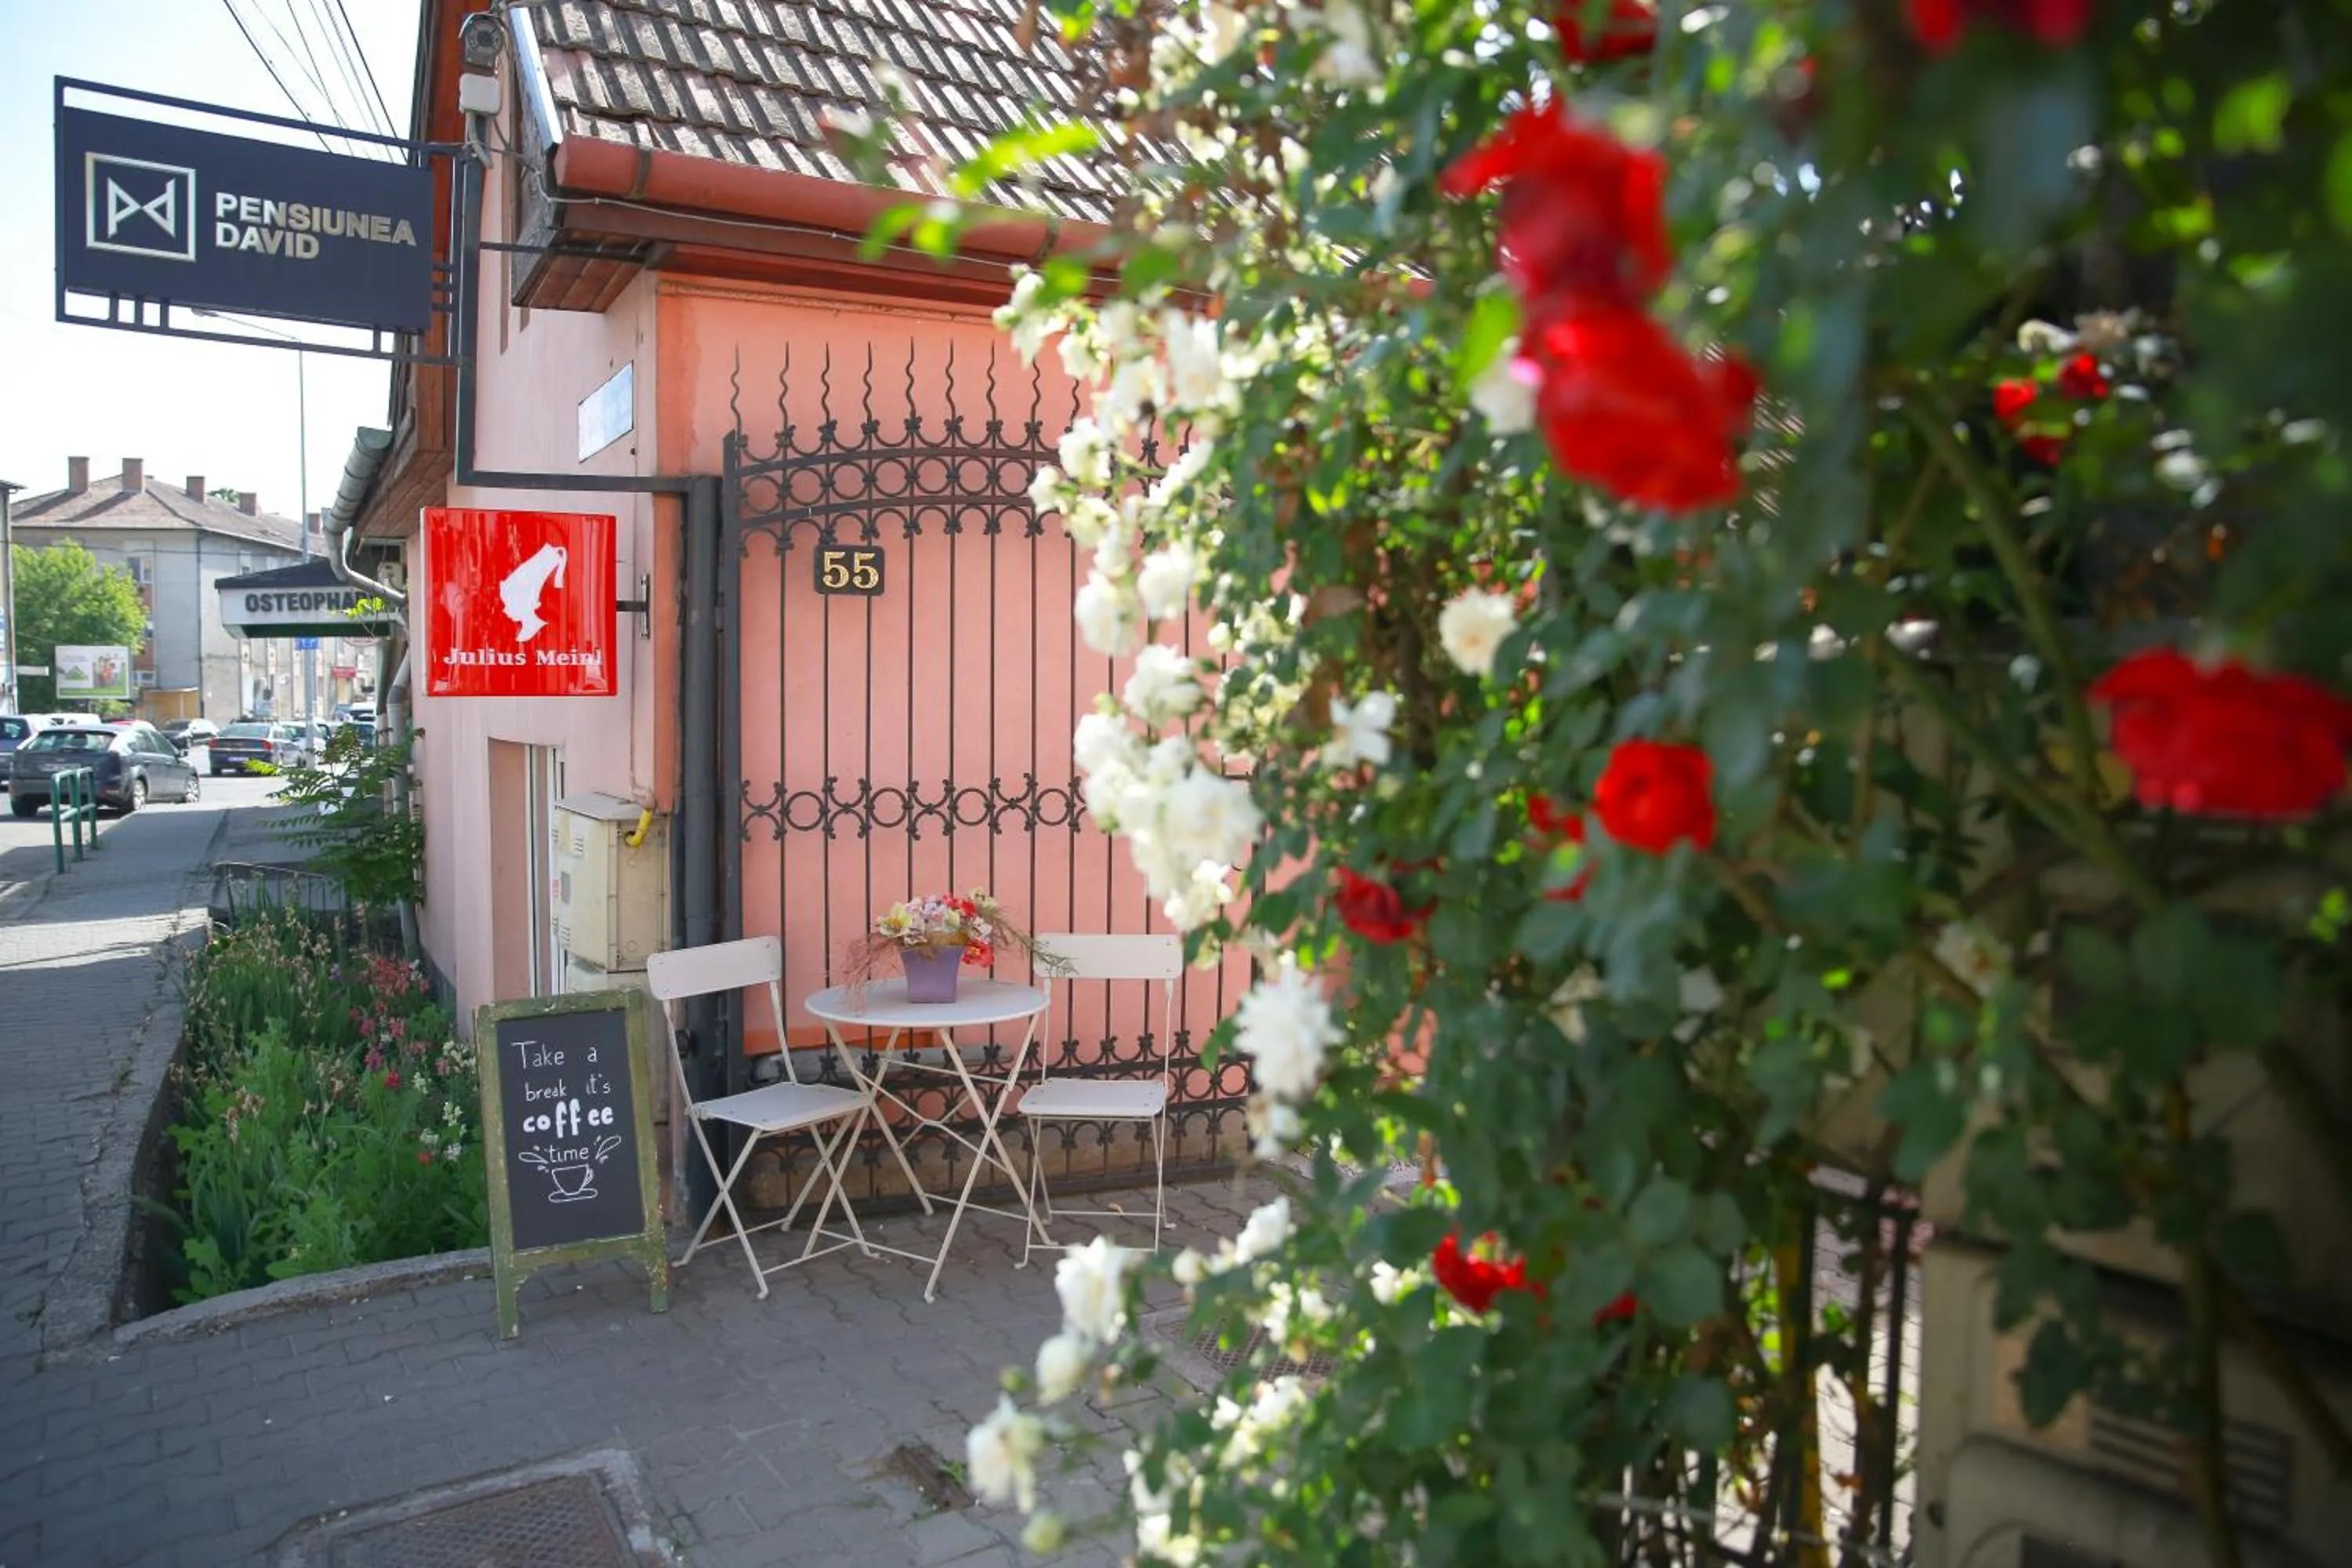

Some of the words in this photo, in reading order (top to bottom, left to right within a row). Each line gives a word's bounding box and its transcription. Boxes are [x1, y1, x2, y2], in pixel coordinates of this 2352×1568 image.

[216, 192, 417, 247] PENSIUNEA
[216, 222, 320, 260] DAVID
[822, 551, 879, 589] 55
[443, 648, 526, 666] Julius
[536, 648, 602, 666] Meinl
[511, 1040, 564, 1069] Take
[587, 1047, 598, 1062] a
[524, 1079, 567, 1102] break
[586, 1073, 611, 1094] it's
[523, 1098, 615, 1138] coffee
[549, 1145, 590, 1163] time
